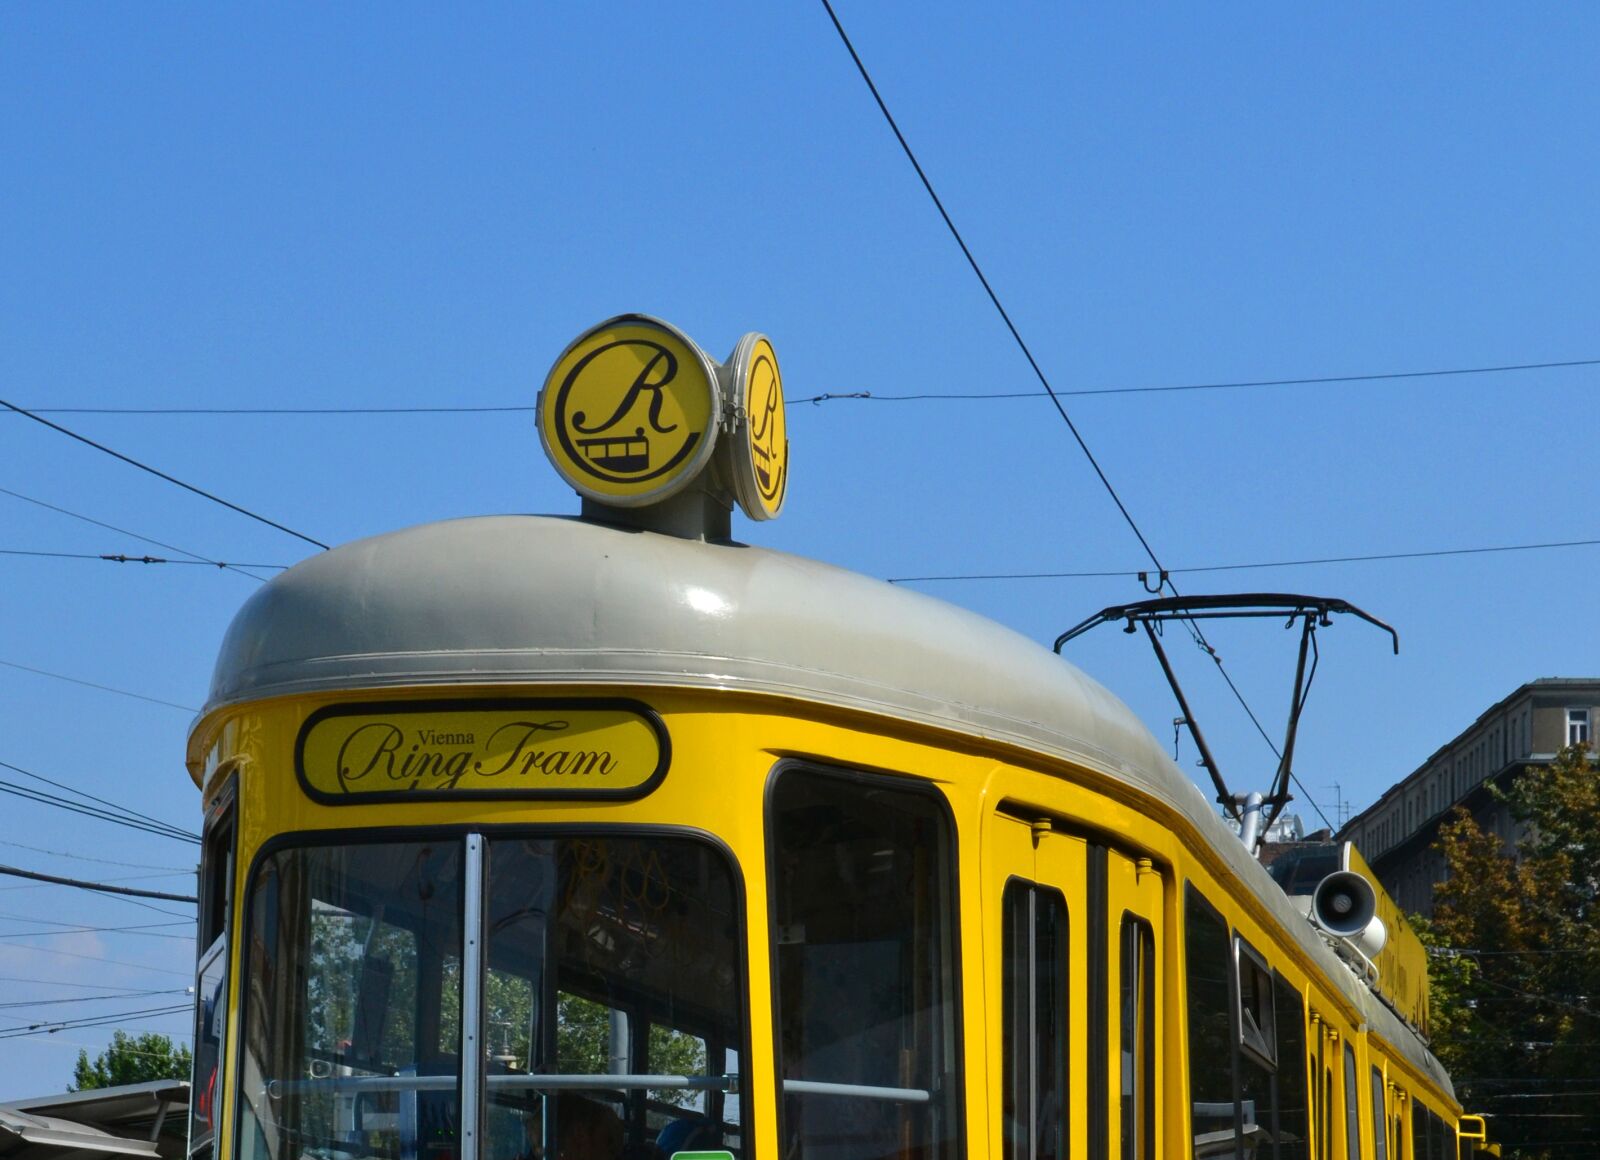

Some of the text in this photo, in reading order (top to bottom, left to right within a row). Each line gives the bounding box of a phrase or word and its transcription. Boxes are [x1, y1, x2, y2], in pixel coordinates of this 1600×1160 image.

[554, 339, 680, 440] R
[337, 720, 618, 793] Ring Tram
[417, 729, 475, 745] Vienna
